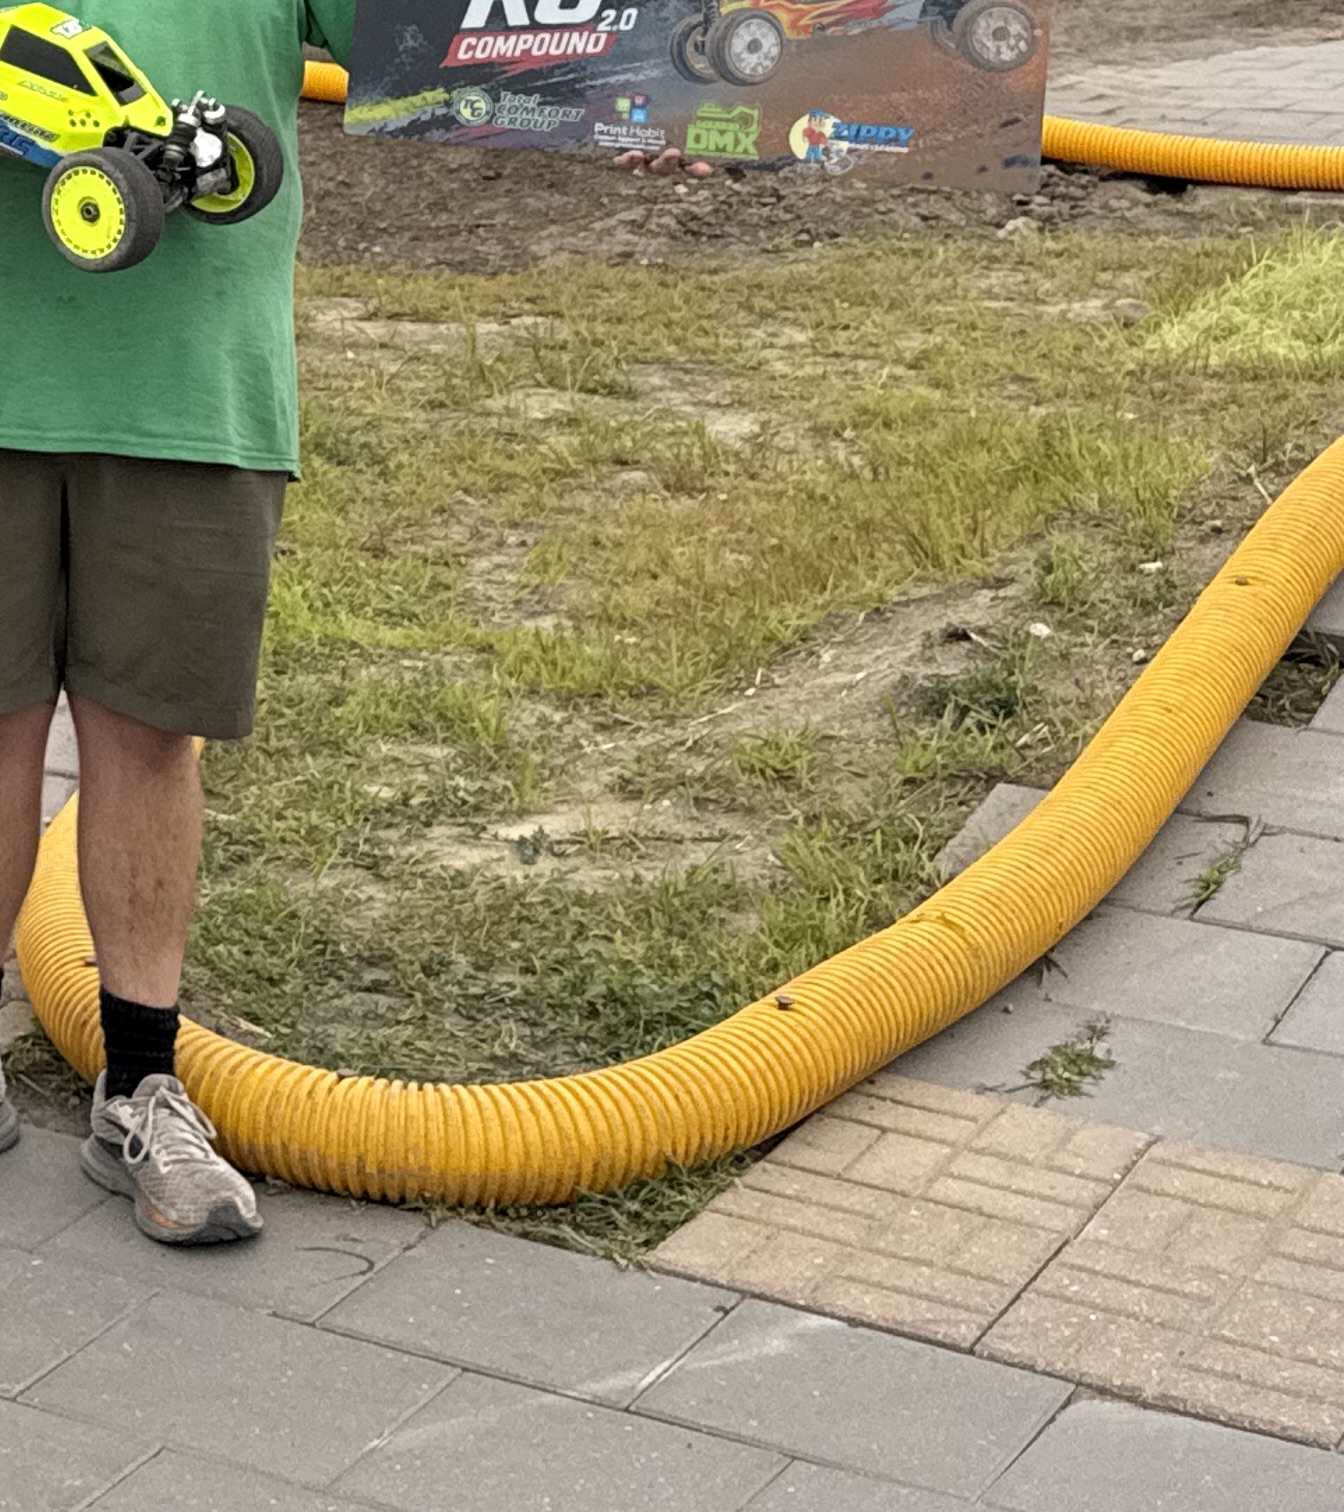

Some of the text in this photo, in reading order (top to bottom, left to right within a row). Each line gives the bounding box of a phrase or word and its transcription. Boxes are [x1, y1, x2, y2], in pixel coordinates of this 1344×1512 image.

[597, 7, 638, 32] 2.0
[457, 31, 609, 61] COMPOUND
[500, 91, 539, 105] Total
[494, 104, 585, 122] COMFORT
[492, 117, 561, 132] GROUP
[594, 122, 628, 136] Print
[831, 121, 915, 147] ZIPPY
[687, 126, 759, 154] DMX
